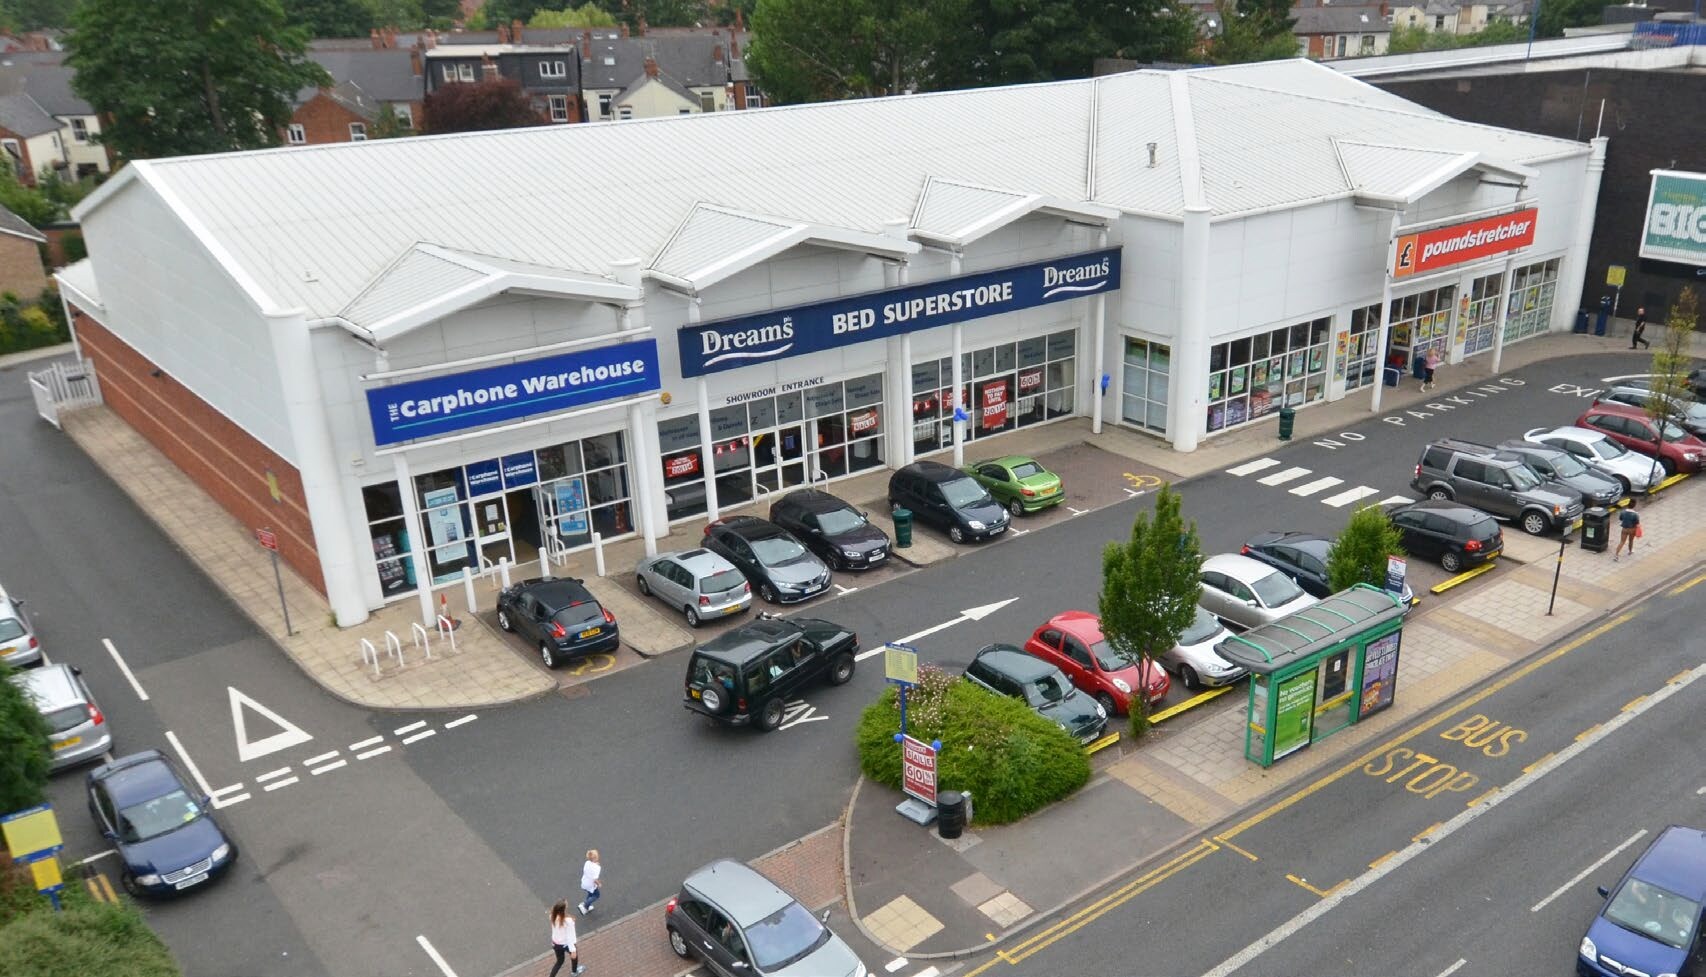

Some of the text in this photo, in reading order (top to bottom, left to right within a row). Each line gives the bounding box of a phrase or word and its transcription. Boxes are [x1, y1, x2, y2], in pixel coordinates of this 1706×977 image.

[1421, 220, 1532, 262] poundstretcher
[1043, 261, 1110, 287] Dreams
[832, 281, 1013, 335] BED SUPERSTORE
[700, 321, 794, 354] Dreams
[388, 358, 645, 422] THE Carphone Warehouse
[726, 376, 825, 404] SHOWROOM ENTRANCE
[1547, 383, 1604, 398] EXI
[984, 403, 1005, 415] 2014
[1313, 377, 1526, 450] NO PARKING
[1440, 714, 1528, 757] BUS
[907, 750, 933, 767] SALE
[1363, 748, 1479, 799] STOP
